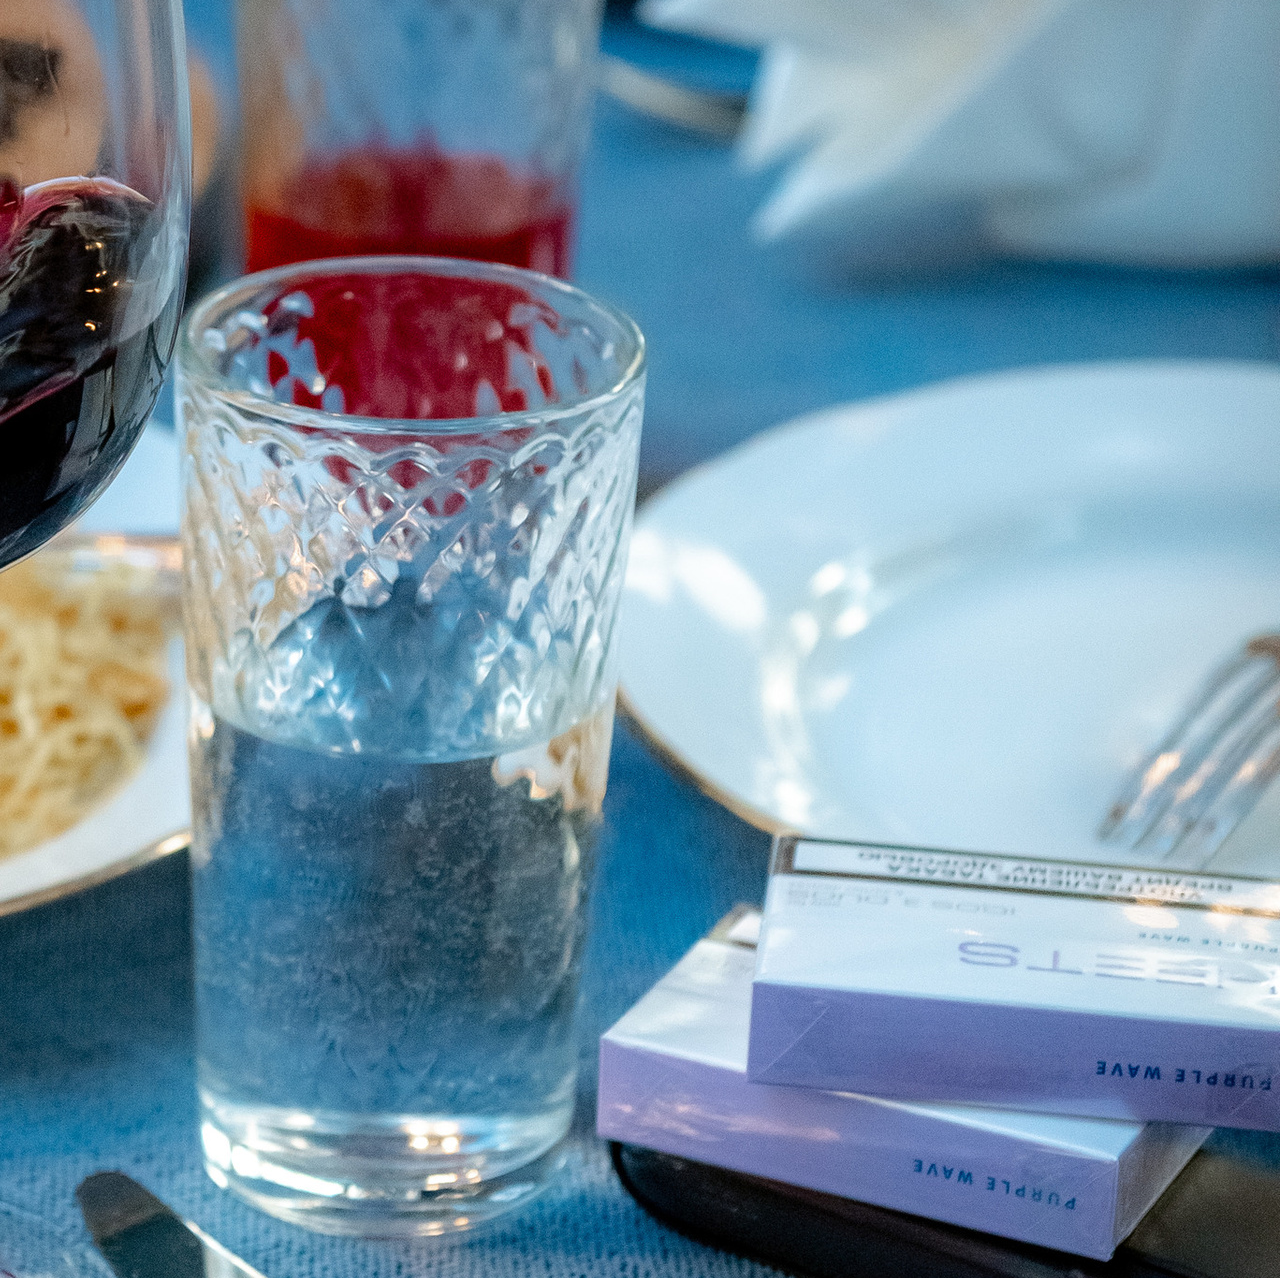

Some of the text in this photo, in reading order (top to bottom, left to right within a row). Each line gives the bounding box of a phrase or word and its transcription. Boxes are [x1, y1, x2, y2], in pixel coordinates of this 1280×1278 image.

[888, 863, 984, 881] ТАБАКА
[1097, 1061, 1272, 1091] PURPLE WAVE
[913, 1159, 1077, 1211] PURPLE WAVE
